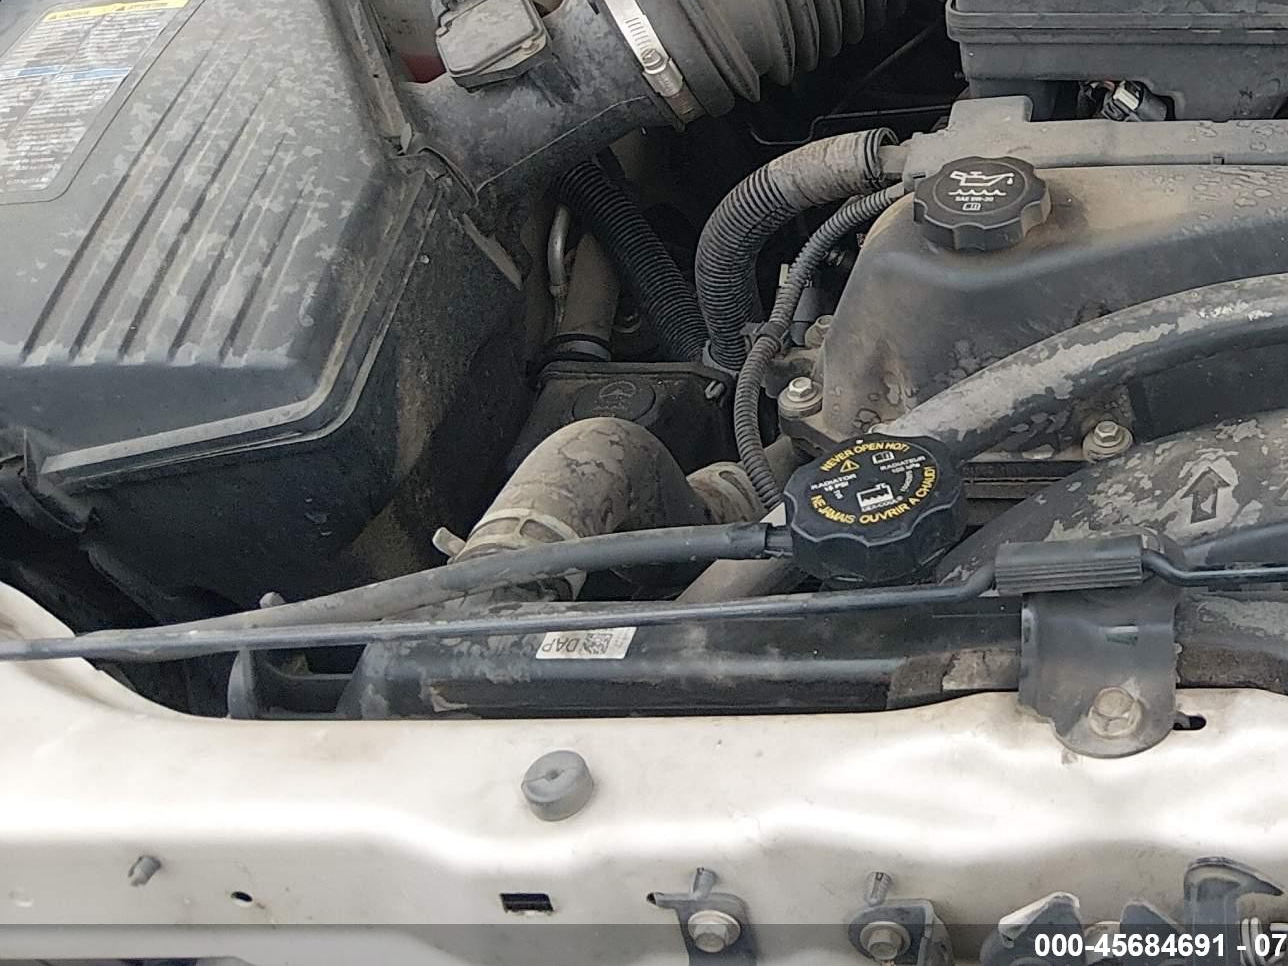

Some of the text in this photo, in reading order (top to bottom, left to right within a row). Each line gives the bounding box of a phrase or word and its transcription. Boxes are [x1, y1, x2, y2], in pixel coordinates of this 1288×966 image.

[820, 442, 910, 472] NEVER OPEN HOT!
[810, 473, 857, 491] RADIATOR
[811, 495, 826, 509] NE
[819, 506, 856, 524] JAMAIS
[859, 503, 910, 523] OUVRIR
